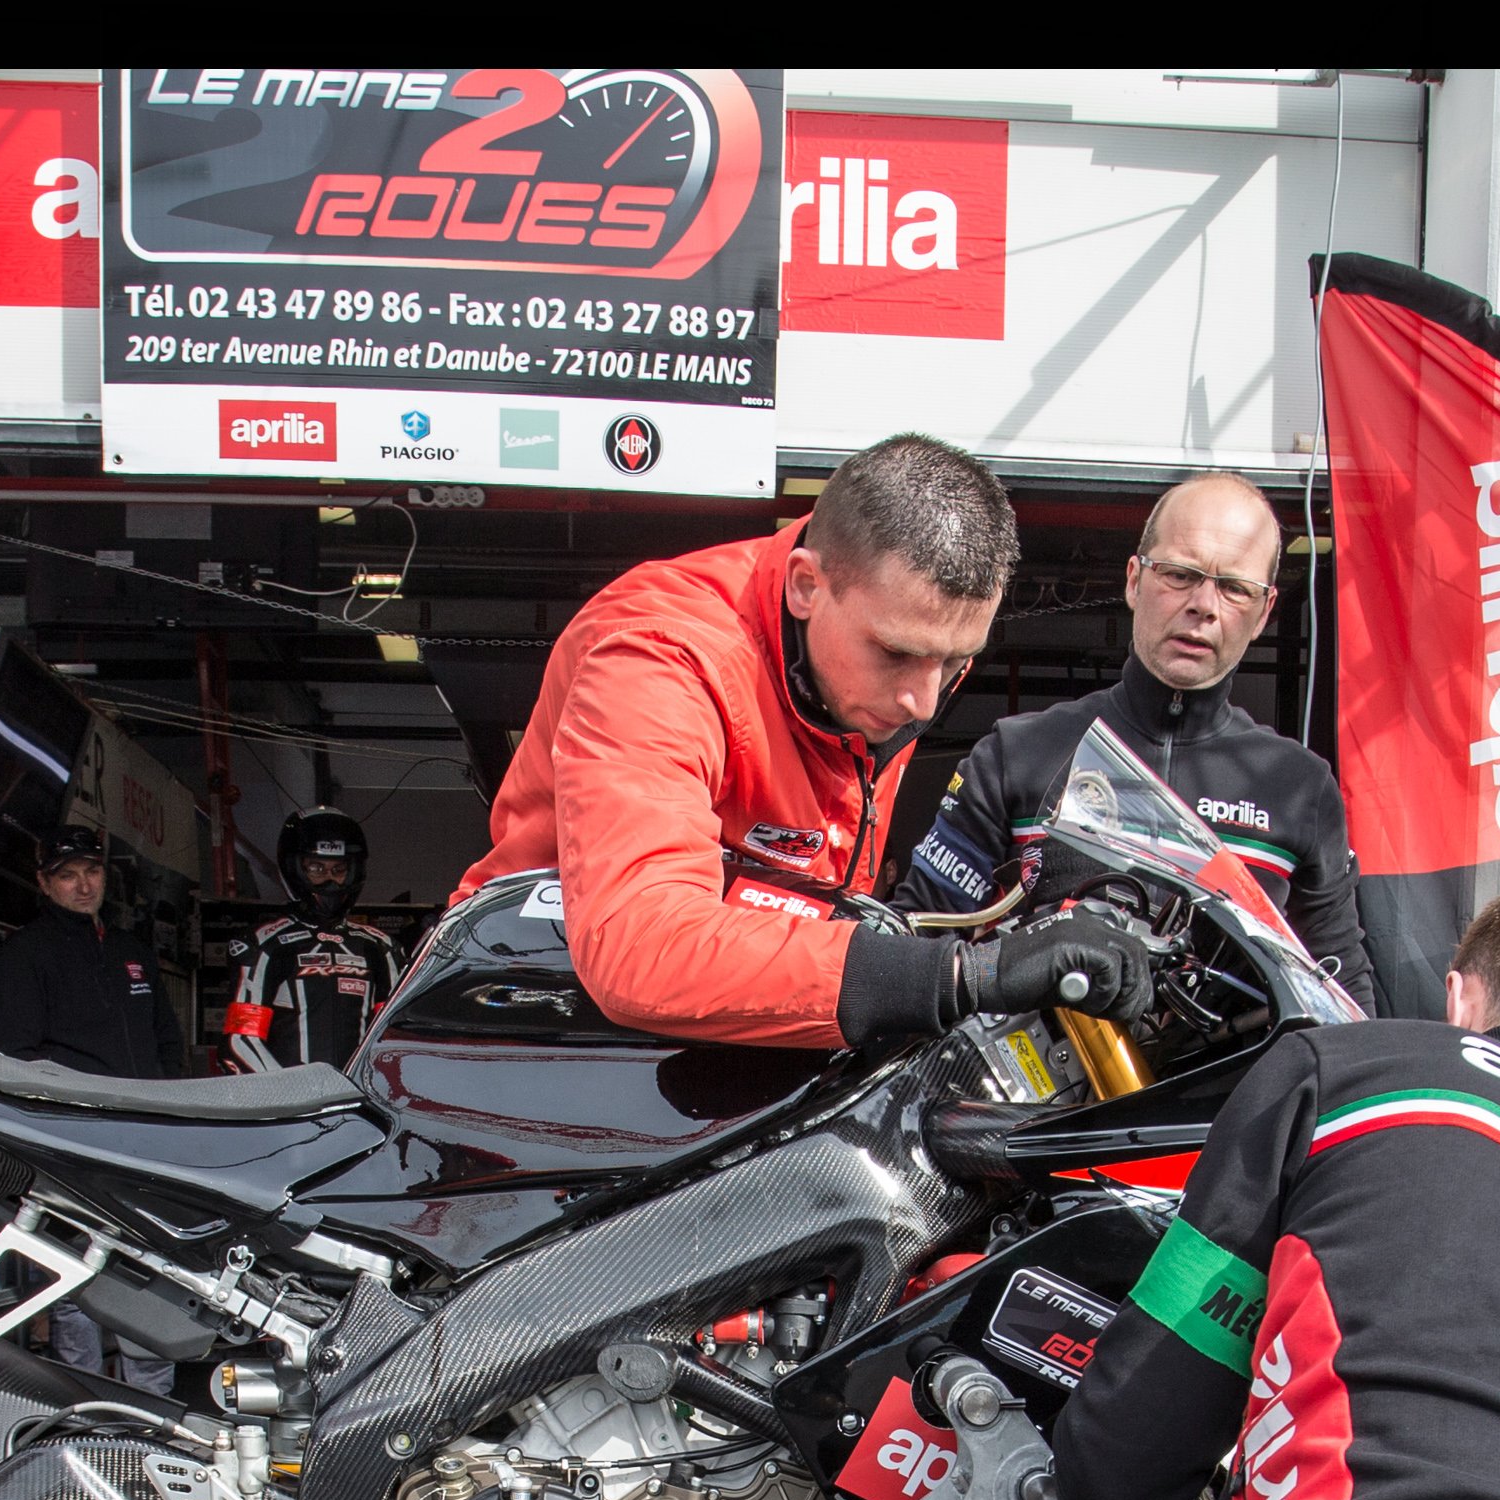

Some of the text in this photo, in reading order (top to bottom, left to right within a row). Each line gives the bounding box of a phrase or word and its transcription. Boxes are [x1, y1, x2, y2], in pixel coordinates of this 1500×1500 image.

[148, 69, 448, 110] LE MANS
[419, 69, 567, 176] 2
[295, 174, 676, 250] ROUES
[188, 286, 230, 319] 02
[236, 287, 278, 319] 43
[284, 289, 326, 320] 47
[333, 290, 374, 322] 89
[381, 291, 422, 323] 86
[449, 293, 505, 327] Fax
[526, 297, 567, 330] 02
[574, 300, 614, 332] 43
[621, 302, 662, 334] 27
[668, 305, 709, 338] 88
[715, 308, 756, 340] 97
[125, 334, 177, 363] 209
[181, 336, 220, 364] ter
[222, 336, 323, 366] Avenue
[327, 338, 388, 368] Rhin
[393, 342, 422, 370] et
[425, 341, 531, 374] Danube
[550, 348, 634, 379] 72100
[637, 352, 670, 381] LE
[672, 354, 753, 386] MANS
[230, 412, 325, 448] aprilia
[1197, 796, 1270, 830] aprilia
[739, 886, 821, 920] aprilia
[1016, 1279, 1109, 1329] LE MANS
